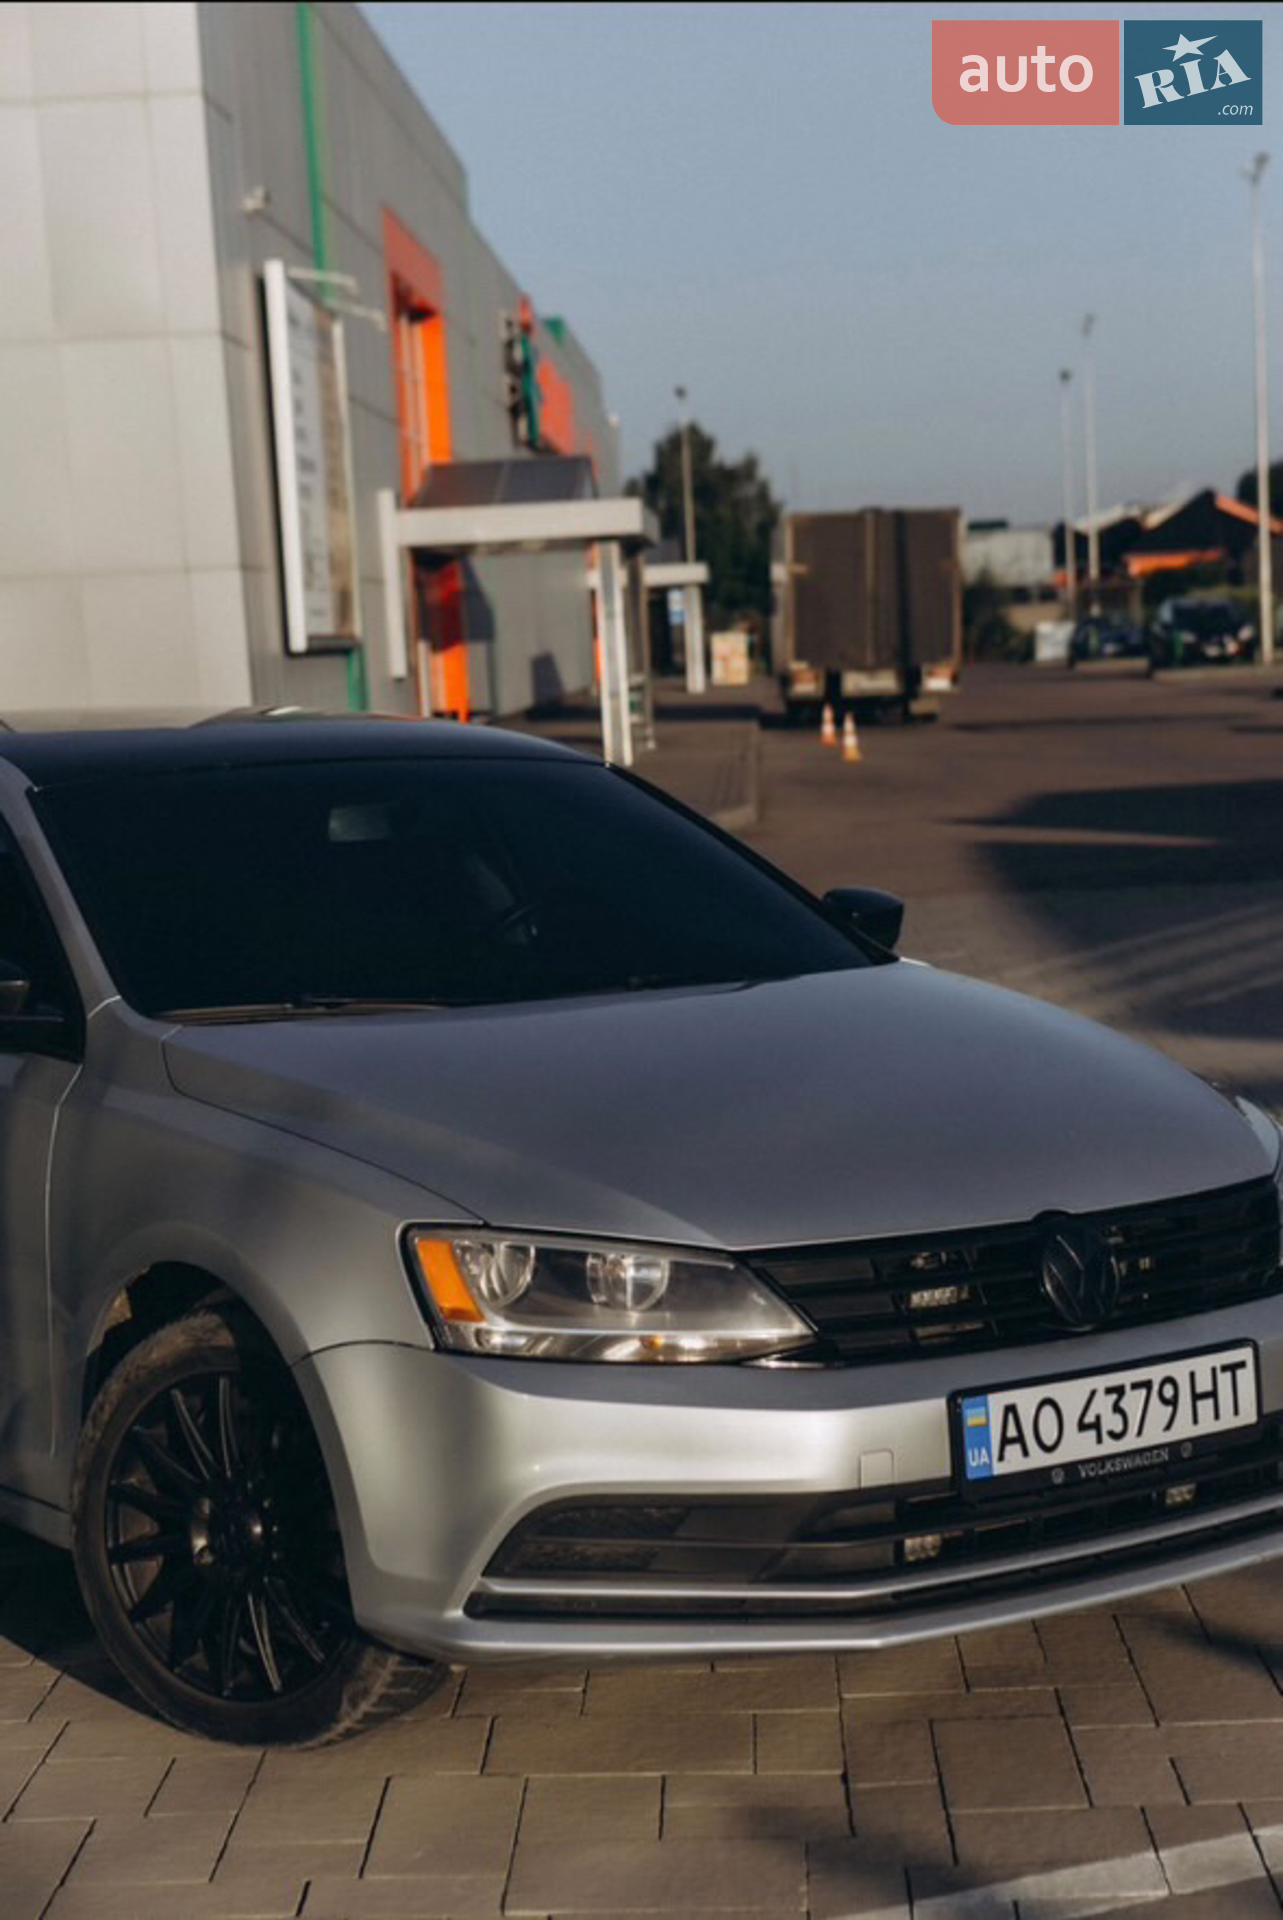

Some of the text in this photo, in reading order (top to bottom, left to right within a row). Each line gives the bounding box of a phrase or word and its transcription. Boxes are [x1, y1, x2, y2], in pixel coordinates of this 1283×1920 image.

[996, 1359, 1248, 1463] AO 4379 HT
[968, 1447, 991, 1467] UA
[1077, 1447, 1170, 1478] VOLKSWAGEN
